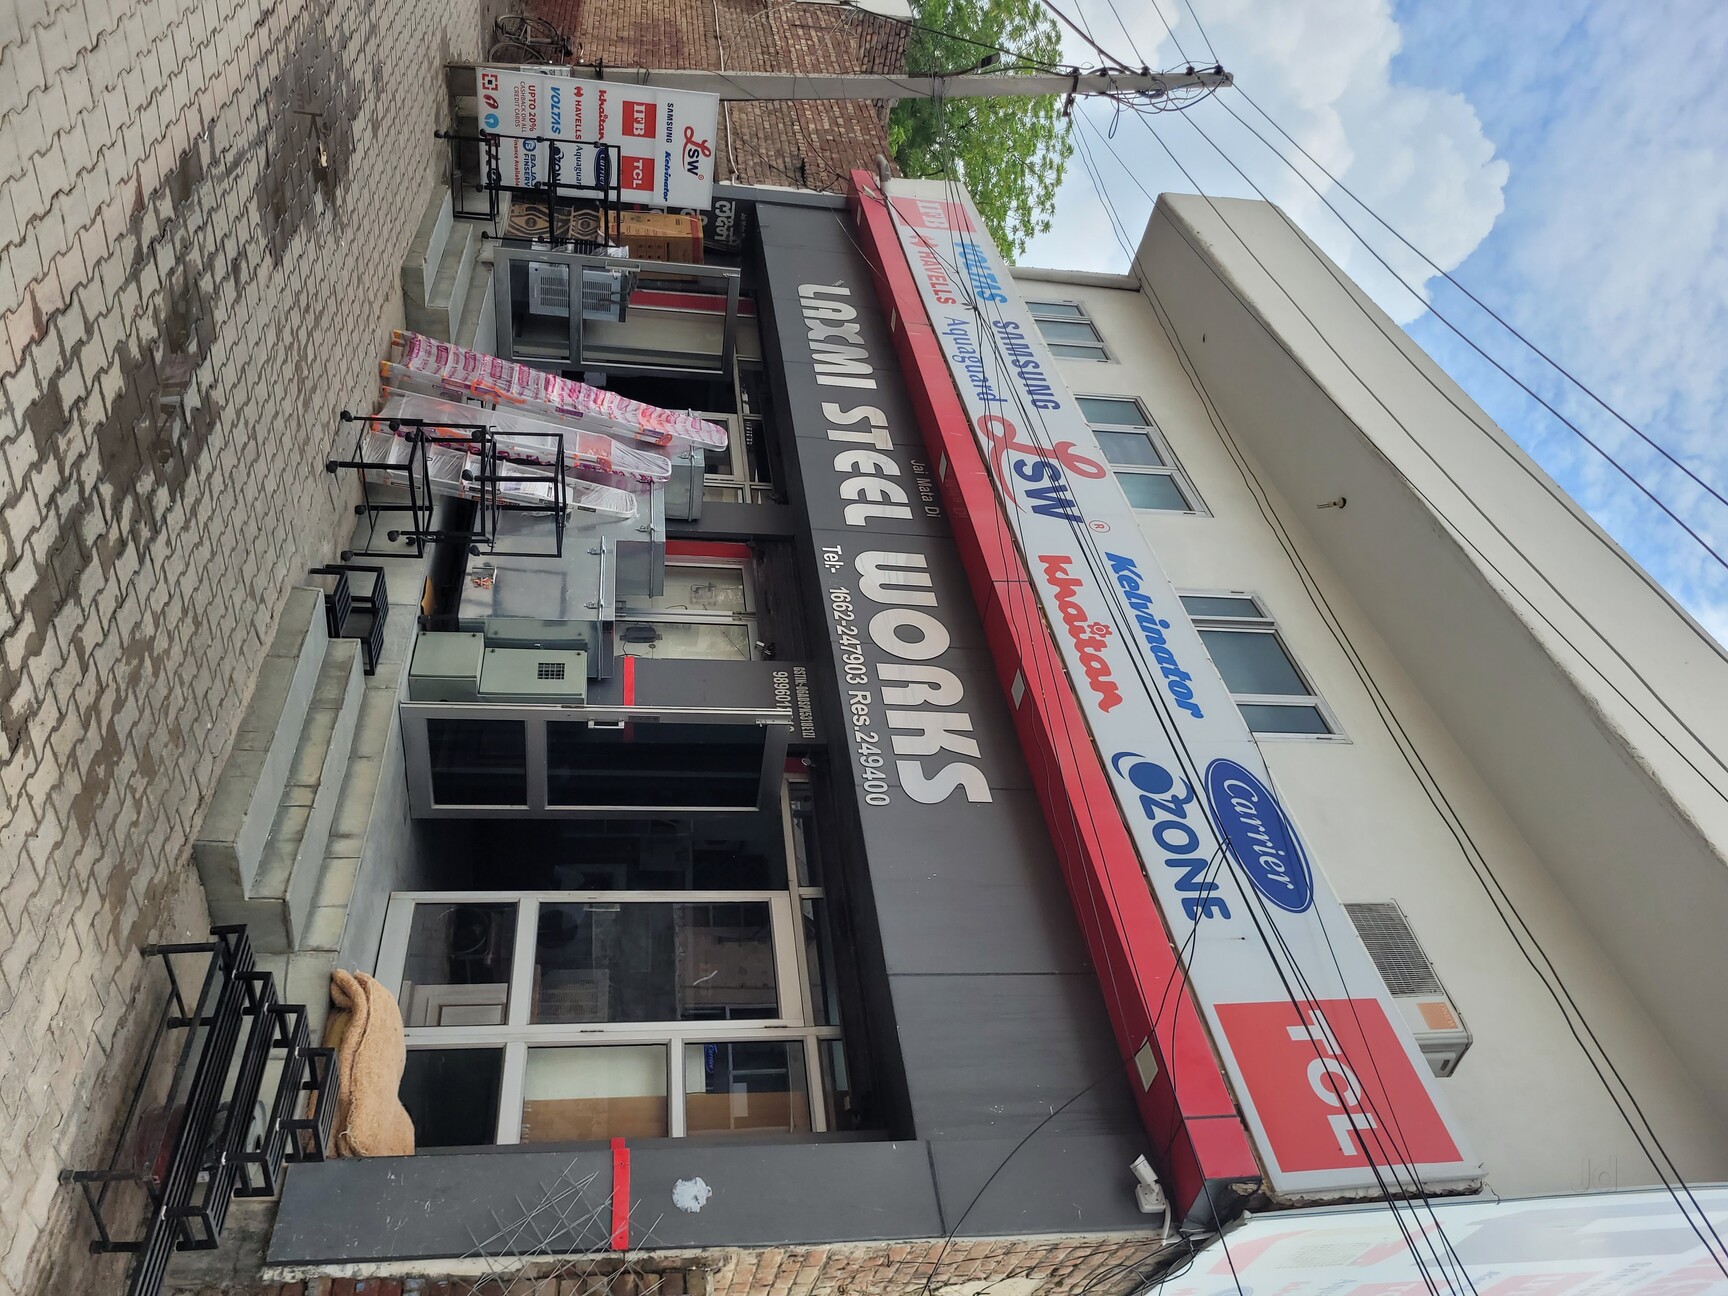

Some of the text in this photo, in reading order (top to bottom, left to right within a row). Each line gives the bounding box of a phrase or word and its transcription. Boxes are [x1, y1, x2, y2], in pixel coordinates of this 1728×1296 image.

[521, 114, 526, 122] ON
[528, 85, 536, 109] UPTO
[551, 86, 561, 134] VOLTAS
[574, 100, 582, 140] HAVELLS
[598, 90, 608, 141] khaitan
[633, 104, 645, 188] IFB TCL
[663, 102, 674, 202] SAMSUNG Kelvinator
[916, 200, 949, 228] IFB
[916, 251, 957, 304] HAVELLS
[953, 241, 1008, 304] VOLTAS
[941, 316, 1008, 402] Aquaguard
[992, 320, 1061, 410] SAMSUNG
[910, 460, 941, 518] Jai Mata Di
[798, 283, 992, 804] LAXMI STEEL WORKS
[1038, 554, 1124, 713] khaitan
[1105, 552, 1204, 718] Kelvinator
[828, 586, 868, 684] 1662-247903
[848, 690, 890, 806] Res.249400
[1112, 752, 1232, 920] OZONE
[1223, 779, 1296, 890] Carrier
[1286, 1010, 1377, 1156] TCL
